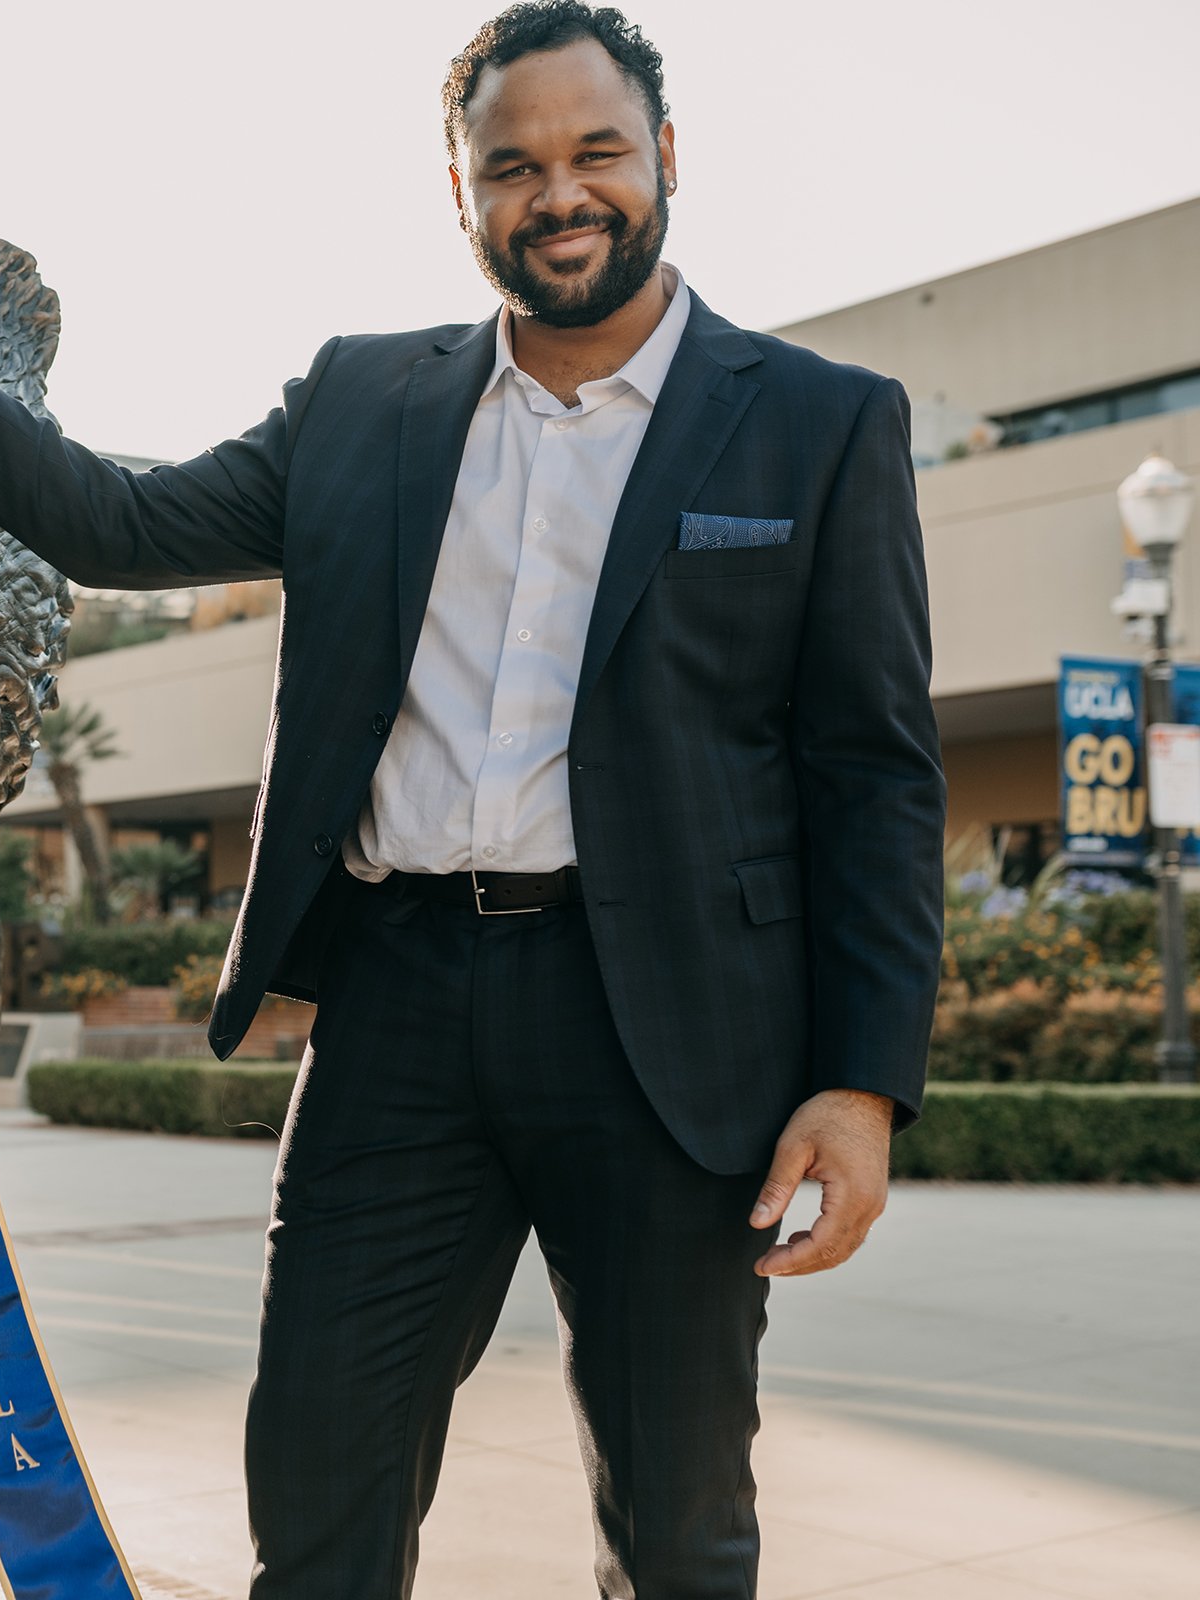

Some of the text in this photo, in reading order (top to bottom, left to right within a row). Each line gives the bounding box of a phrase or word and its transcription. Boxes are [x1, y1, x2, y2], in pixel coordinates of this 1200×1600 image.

[1064, 683, 1134, 720] UCLA
[1065, 732, 1134, 786] GO
[1067, 785, 1146, 837] BRU
